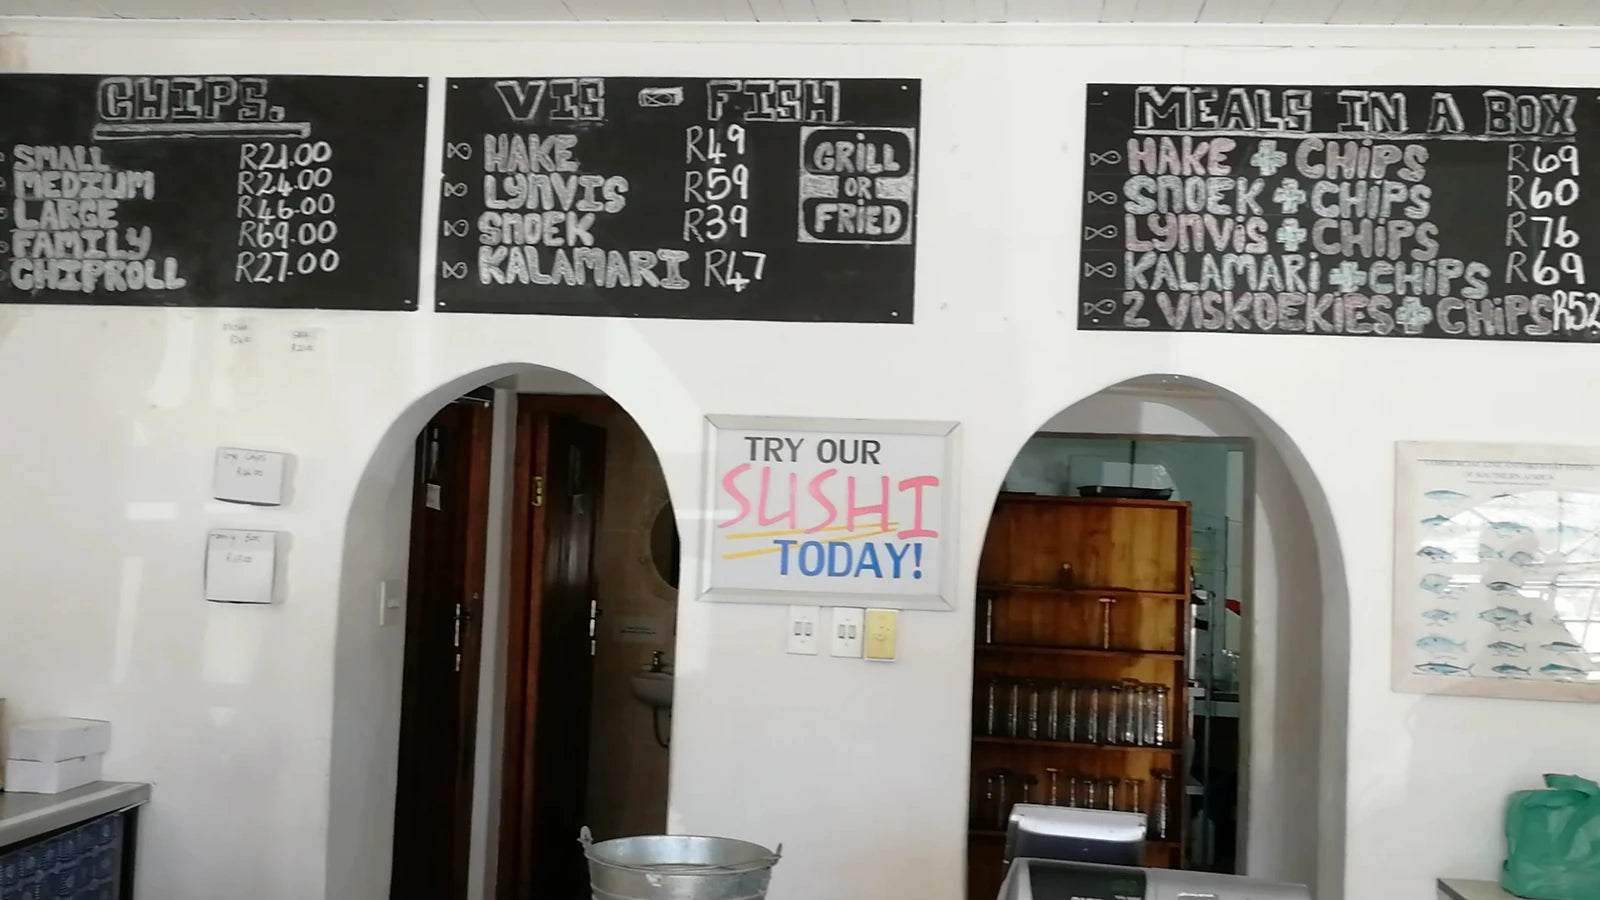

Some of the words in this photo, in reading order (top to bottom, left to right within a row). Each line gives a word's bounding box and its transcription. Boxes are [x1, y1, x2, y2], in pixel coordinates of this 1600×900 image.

[99, 76, 285, 121] CHIPS.
[495, 78, 604, 121] VIS
[707, 79, 840, 122] FISH
[1134, 86, 1312, 132] MEALS
[1337, 90, 1408, 133] IN
[1427, 92, 1465, 133] A
[1482, 90, 1577, 136] BOX
[13, 144, 111, 171] SMALL
[240, 141, 332, 170] R21.00
[484, 133, 580, 173] HAKE
[686, 124, 745, 164] R49
[1126, 136, 1236, 176] HAKE
[1508, 143, 1579, 176] R69
[13, 170, 155, 200] MEDIUM
[238, 167, 332, 197] R24.00
[684, 163, 749, 203] R59
[844, 176, 872, 200] OR
[1506, 175, 1579, 210] R60
[13, 199, 119, 230] LARGE
[237, 193, 335, 225] R46.00
[683, 204, 748, 243] R39
[1505, 211, 1580, 248] R76
[238, 220, 337, 248] R69.00
[235, 250, 340, 284] R27.00
[478, 245, 690, 289] KALAMARI
[704, 249, 766, 292] R47
[1505, 250, 1585, 285] R69
[1123, 290, 1150, 328] 2
[1552, 290, 1600, 331] R52
[744, 436, 804, 462] TRY
[816, 439, 881, 465] OUR
[717, 463, 939, 540] SUSHI
[773, 540, 923, 580] TODAY!
